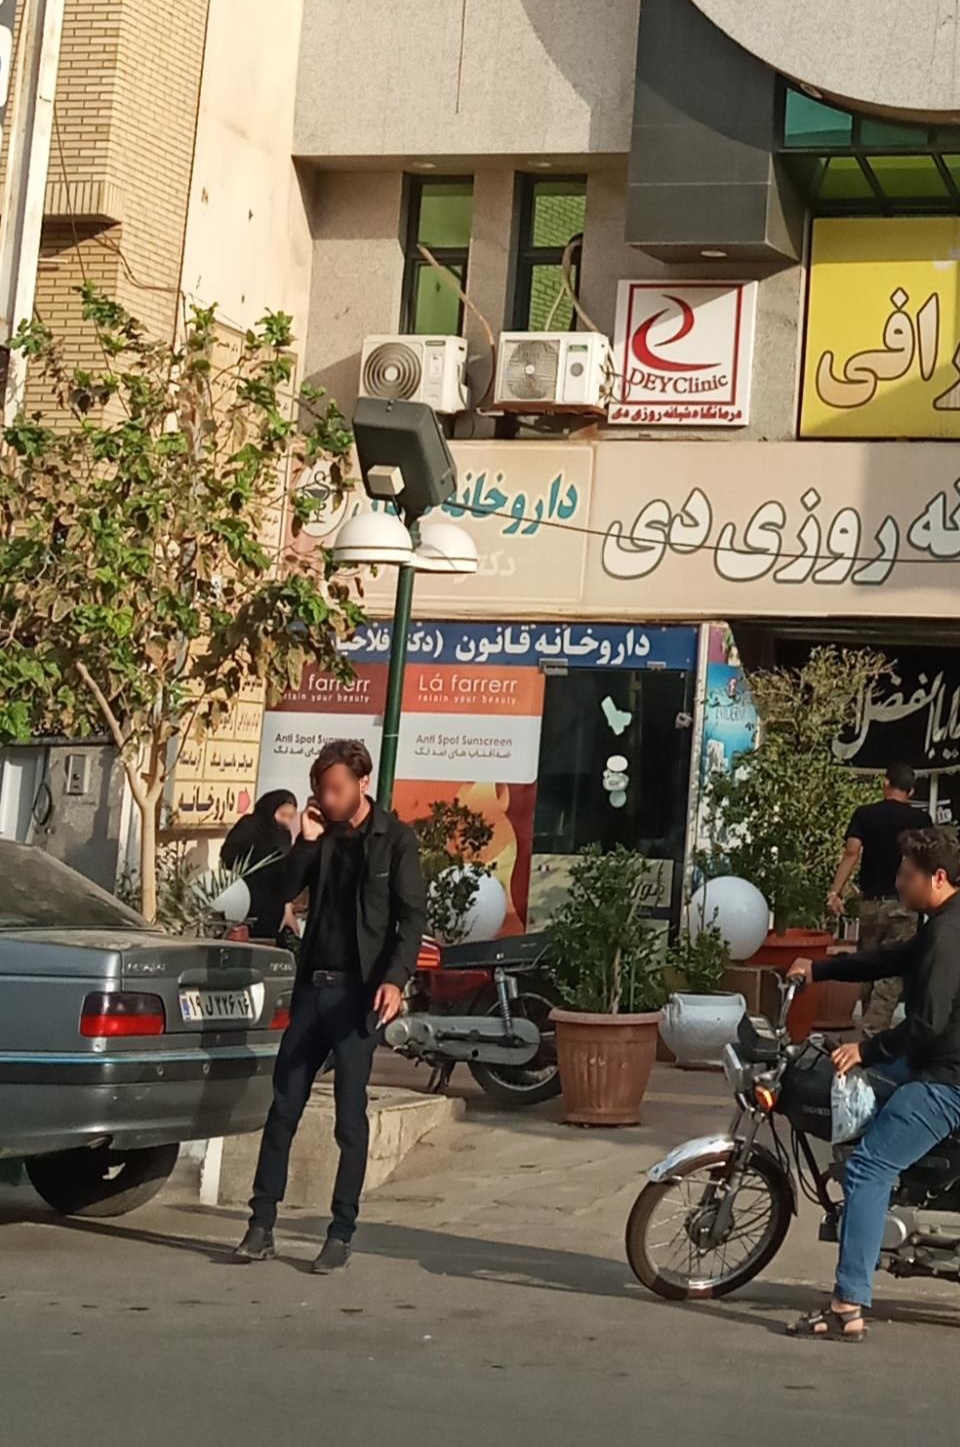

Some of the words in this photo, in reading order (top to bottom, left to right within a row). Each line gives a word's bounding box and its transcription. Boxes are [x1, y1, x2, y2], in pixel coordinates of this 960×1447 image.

[628, 366, 730, 394] DEYClinic
[611, 406, 630, 421] دی
[440, 471, 579, 536] داروخانه
[601, 485, 714, 581] دی
[713, 487, 901, 586] روزی
[454, 624, 535, 663] قانون
[534, 626, 651, 666] داروخانه
[418, 671, 443, 693] Lá
[450, 672, 518, 694] farrerr
[461, 734, 513, 747] Sunscreen
[177, 785, 235, 821] داروخانه
